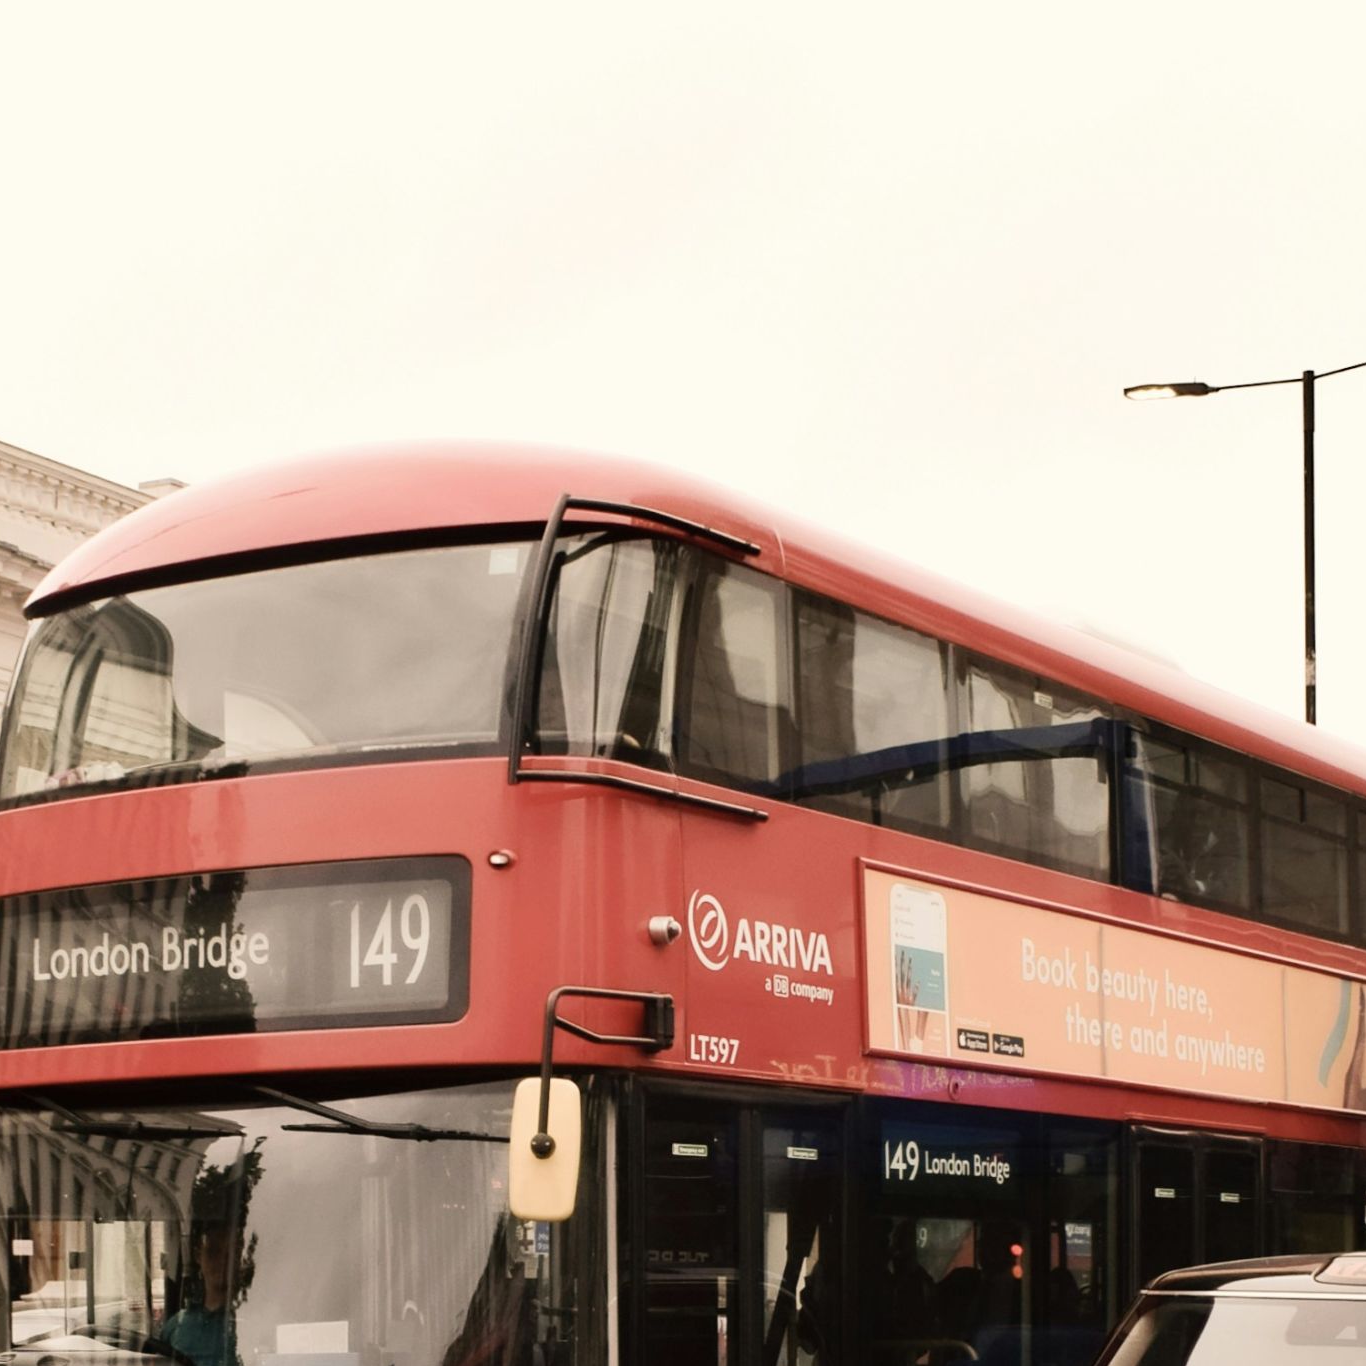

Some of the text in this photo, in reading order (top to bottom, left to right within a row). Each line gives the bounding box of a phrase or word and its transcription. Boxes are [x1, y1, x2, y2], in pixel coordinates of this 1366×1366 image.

[33, 923, 270, 981] London Bridge
[349, 893, 431, 988] 149
[733, 918, 834, 976] ARRIVA
[765, 978, 772, 991] a
[790, 982, 834, 1006] company
[1021, 938, 1214, 1022] Book beauty here,
[690, 1033, 739, 1064] LT597
[1065, 1001, 1266, 1078] there and anywhere
[884, 1140, 1011, 1184] 149 London Bridge
